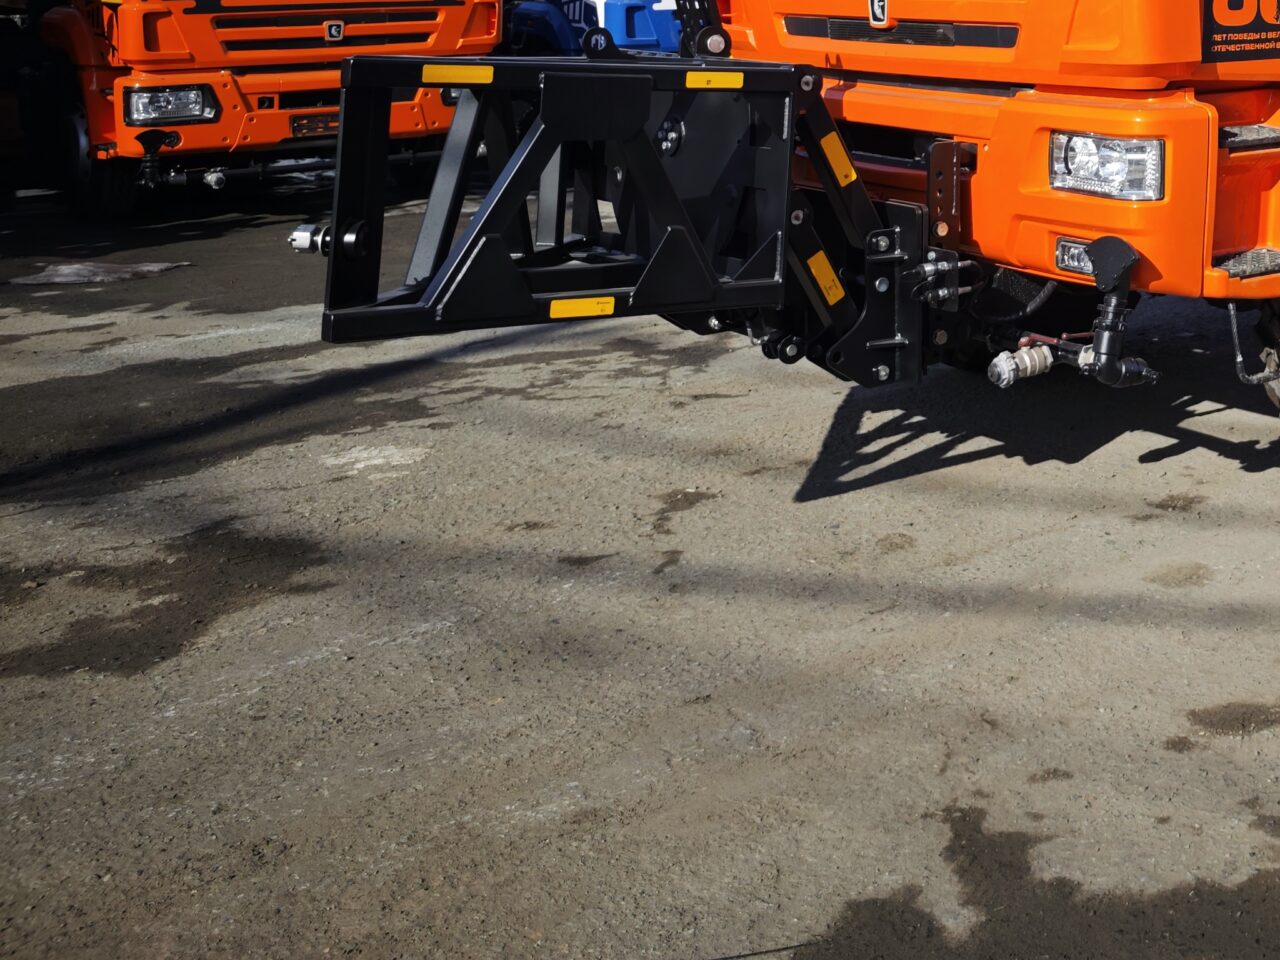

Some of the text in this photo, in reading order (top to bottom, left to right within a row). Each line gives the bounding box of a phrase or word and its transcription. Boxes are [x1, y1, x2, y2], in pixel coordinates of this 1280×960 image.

[1212, 33, 1228, 41] ЛЕТ
[1228, 32, 1260, 41] ПОБЕДЫ
[1260, 31, 1266, 39] В
[1211, 41, 1275, 52] ОТЕЧЕСТВЕННОЙ
